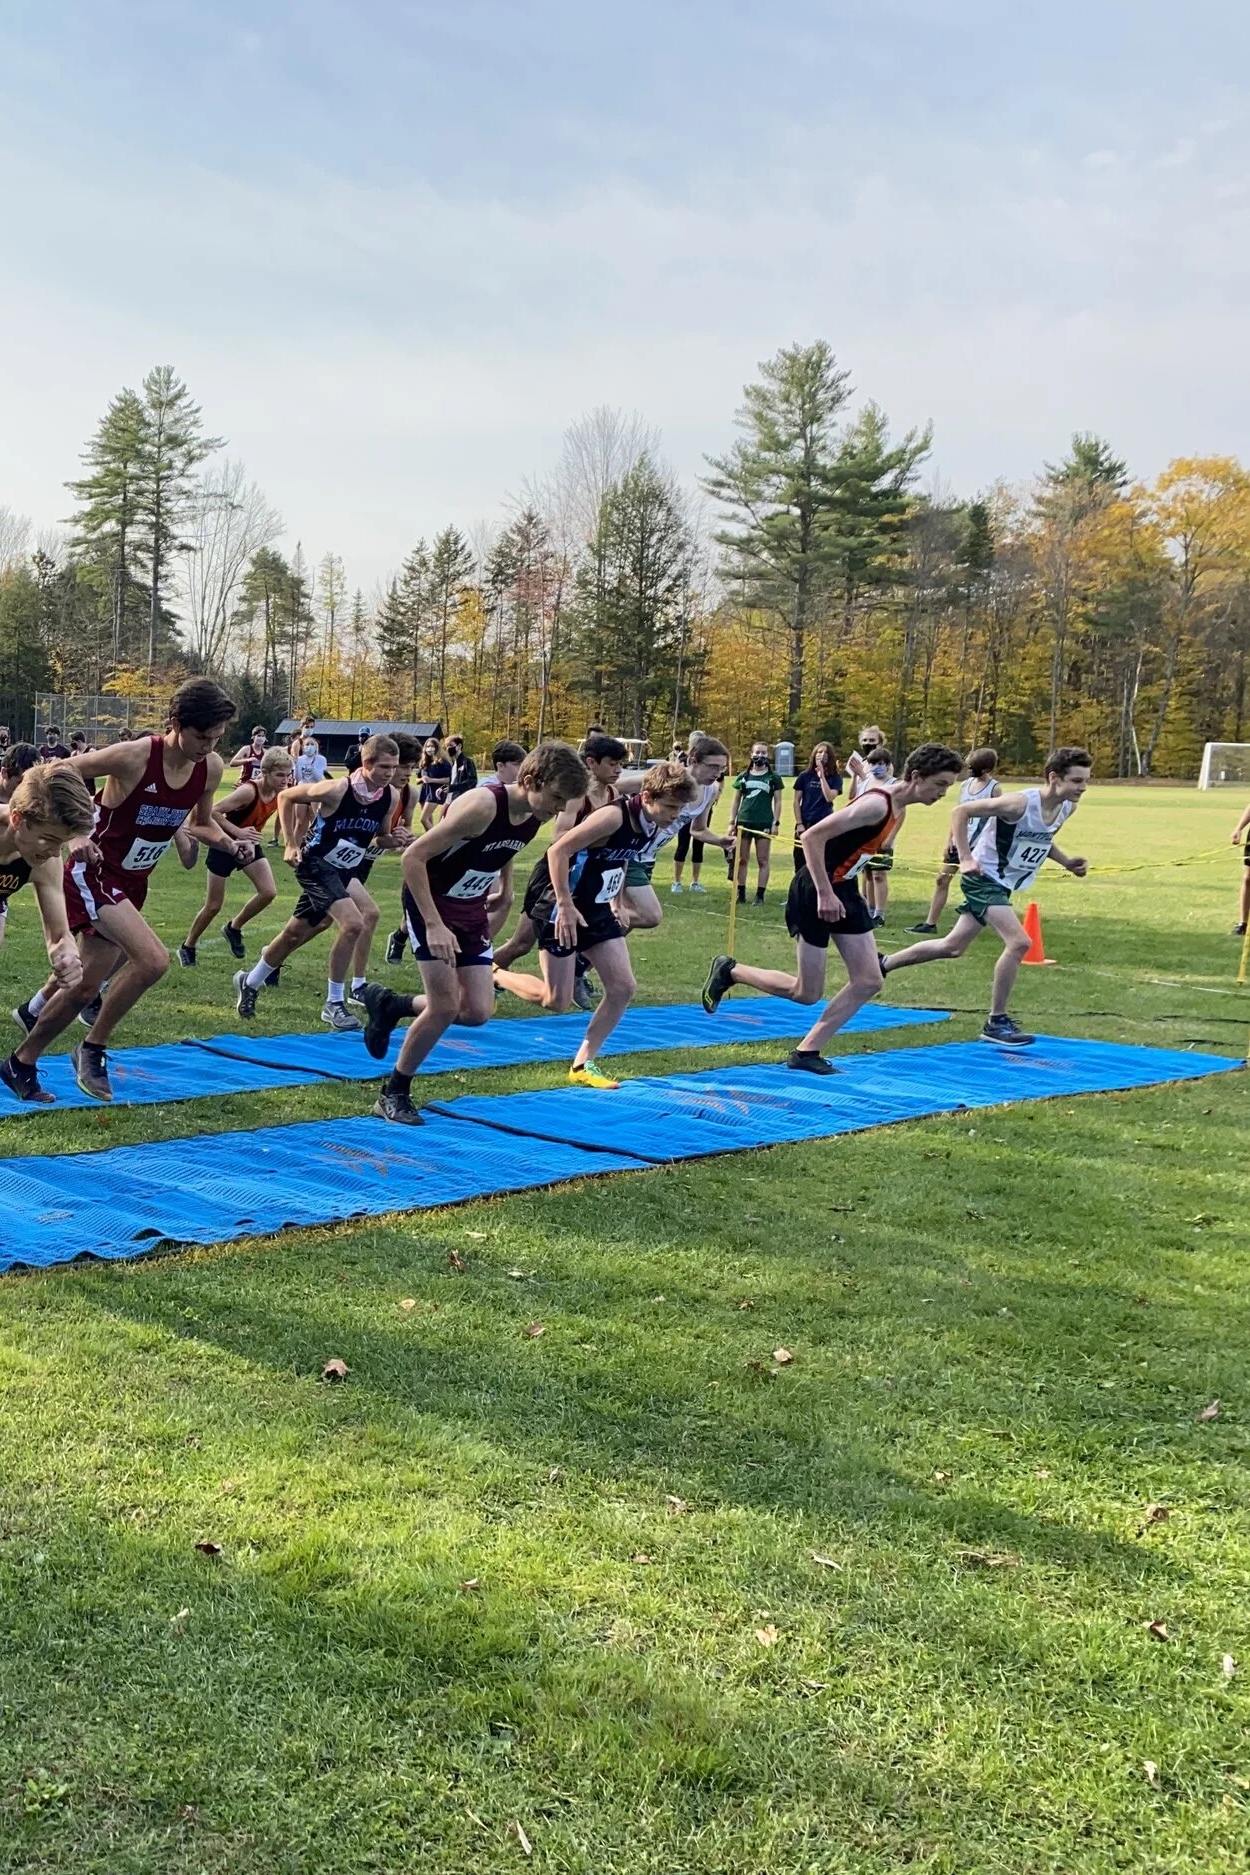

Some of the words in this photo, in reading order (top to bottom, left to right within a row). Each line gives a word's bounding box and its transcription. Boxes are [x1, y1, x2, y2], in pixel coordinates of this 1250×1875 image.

[133, 845, 167, 863] 516
[336, 847, 362, 864] 467
[1020, 846, 1047, 864] 427
